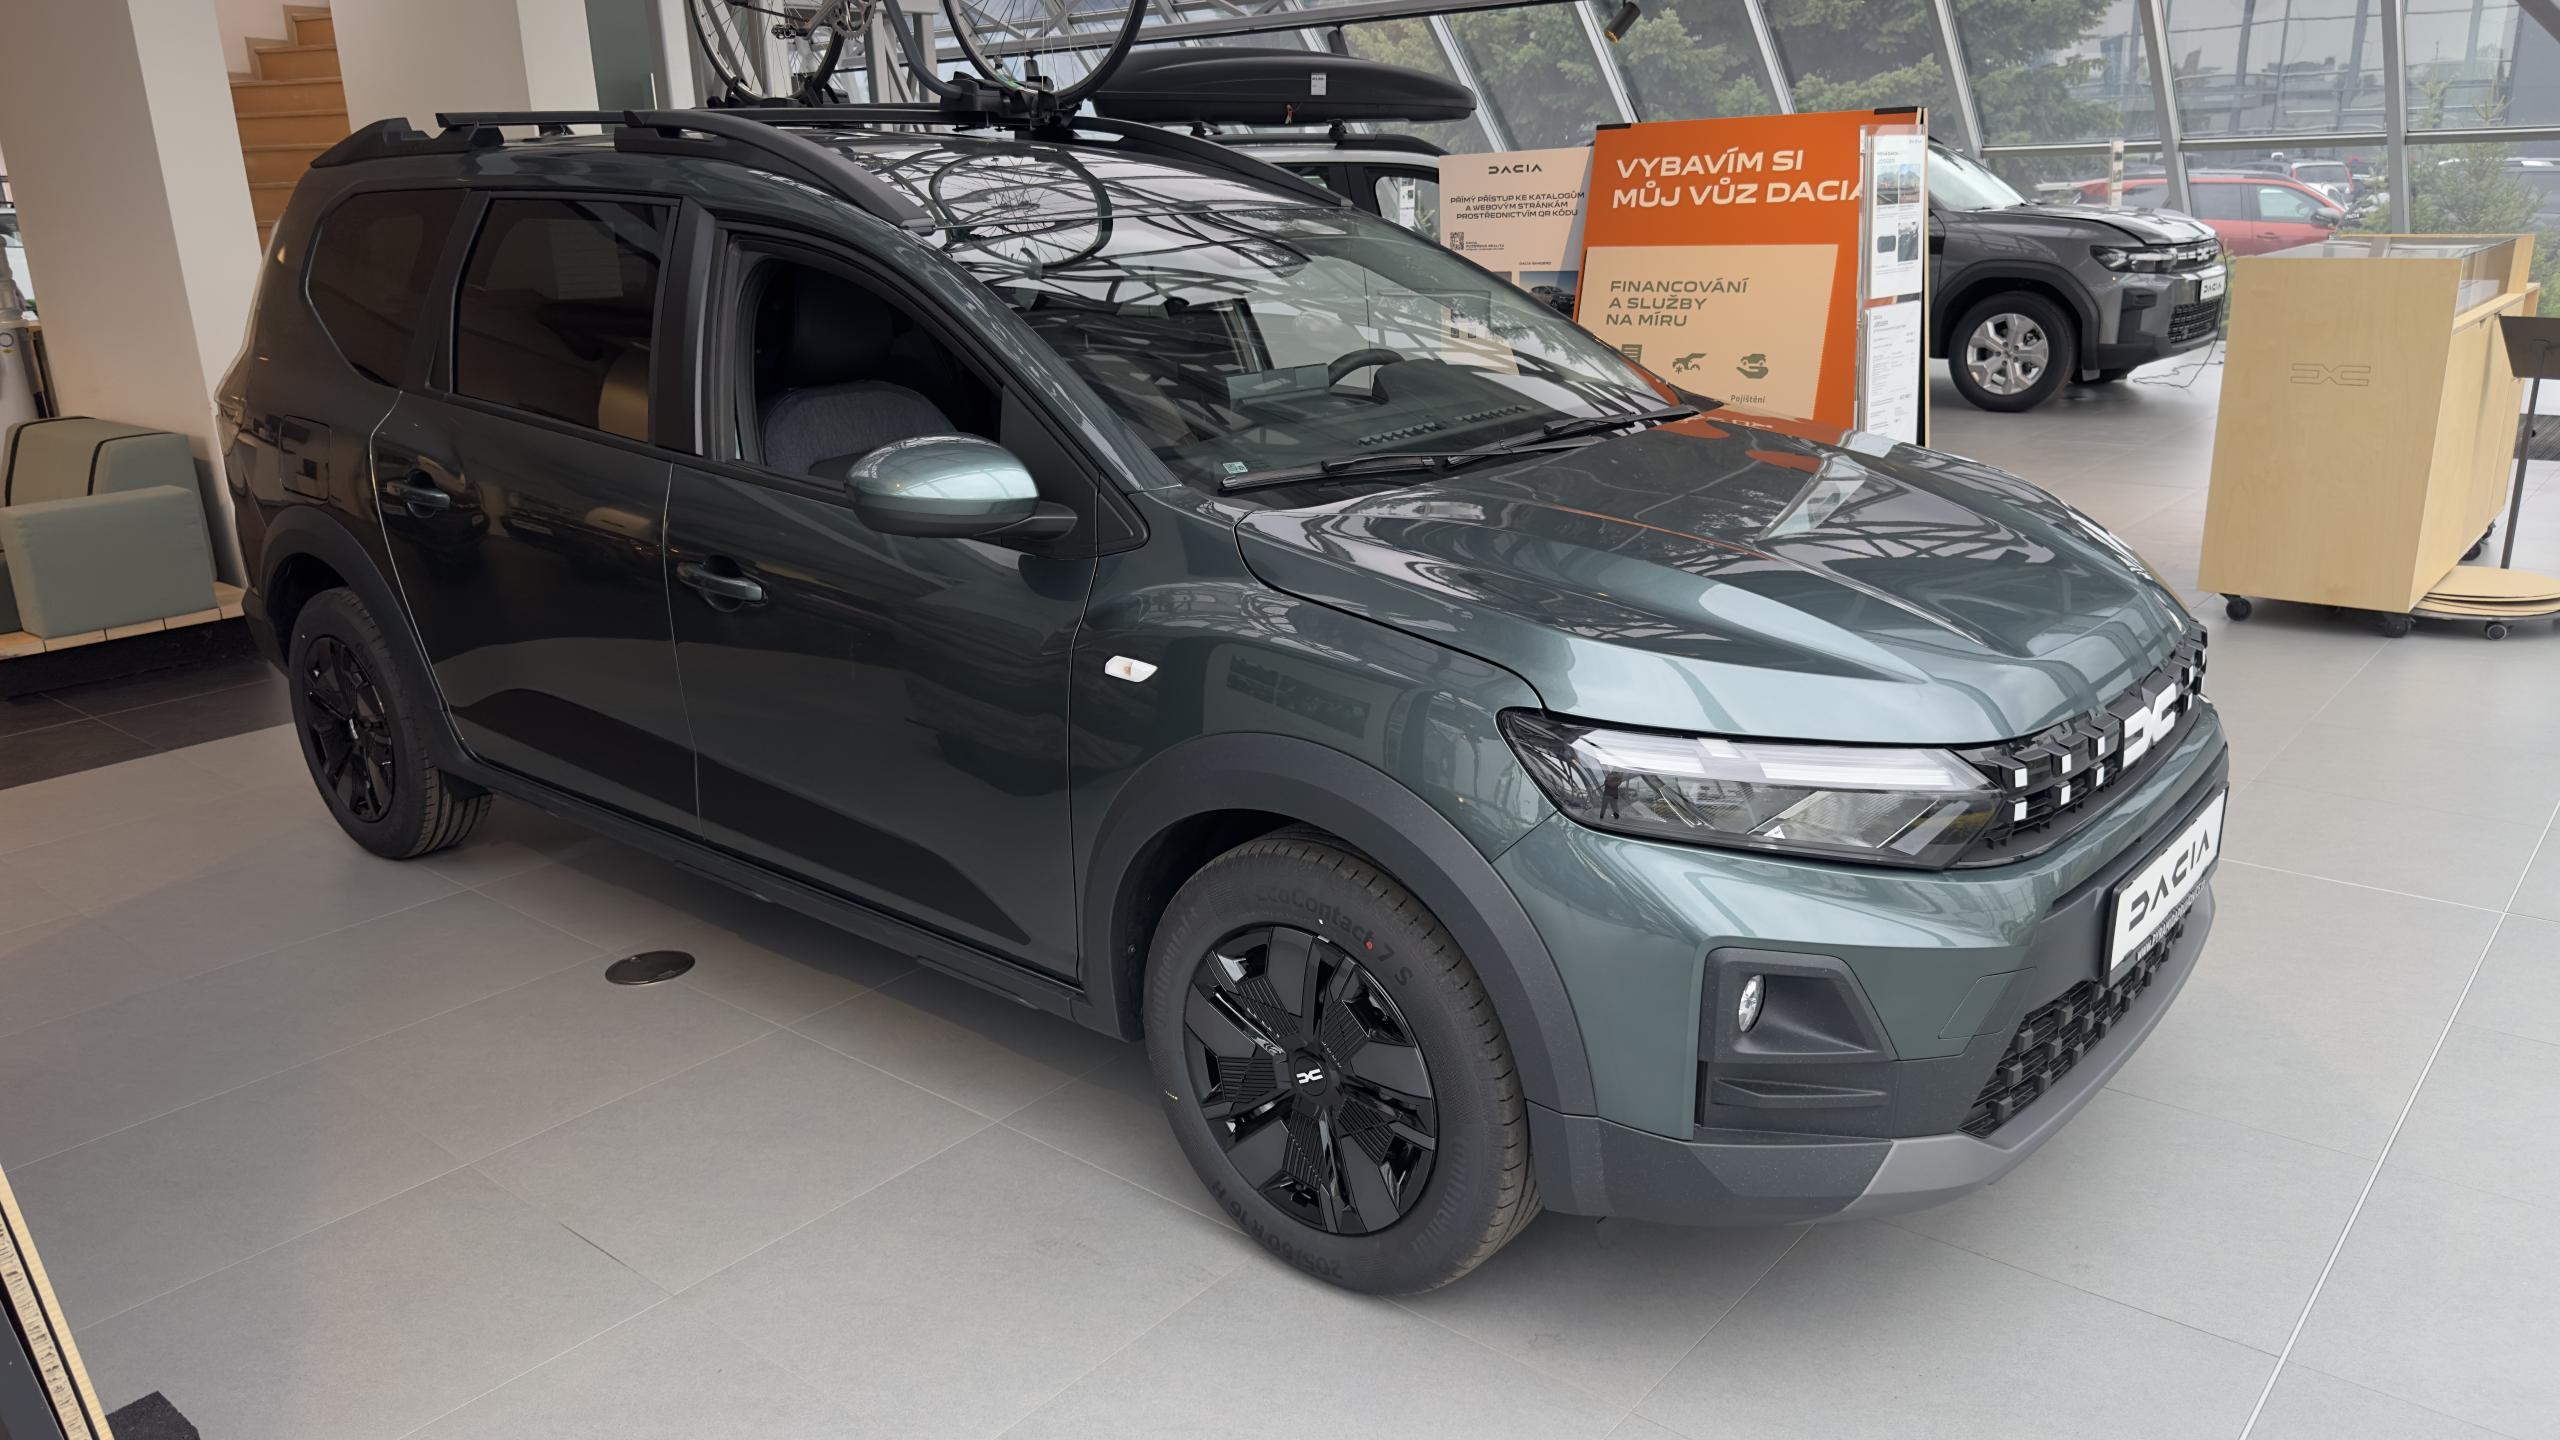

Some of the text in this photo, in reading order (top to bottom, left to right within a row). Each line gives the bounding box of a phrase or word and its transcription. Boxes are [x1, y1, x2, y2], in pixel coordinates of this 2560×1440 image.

[1488, 164, 1542, 175] DACIA
[1617, 147, 1804, 178] VYBAVÍM SI
[1451, 190, 1585, 204] PŘÍMÝ PŘÍSTUP KE KATALOGŮM
[1613, 180, 1681, 209] MŮJ
[1689, 177, 1758, 206] VŮZ
[1473, 202, 1516, 211] WEBOVÝM
[1518, 200, 1568, 209] STRÁNKÁM
[1456, 208, 1578, 220] PROSTŘEDNICTVÍM QR KÓDU
[1610, 277, 1750, 294] FINANCOVÁNÍ
[1608, 294, 1707, 310] A SLUŽBY
[1606, 311, 1688, 327] NA MÍRU
[1730, 394, 1766, 405] Pojištění
[2128, 829, 2210, 932] DACIA
[1377, 943, 1395, 962] 7
[1394, 966, 1413, 986] S
